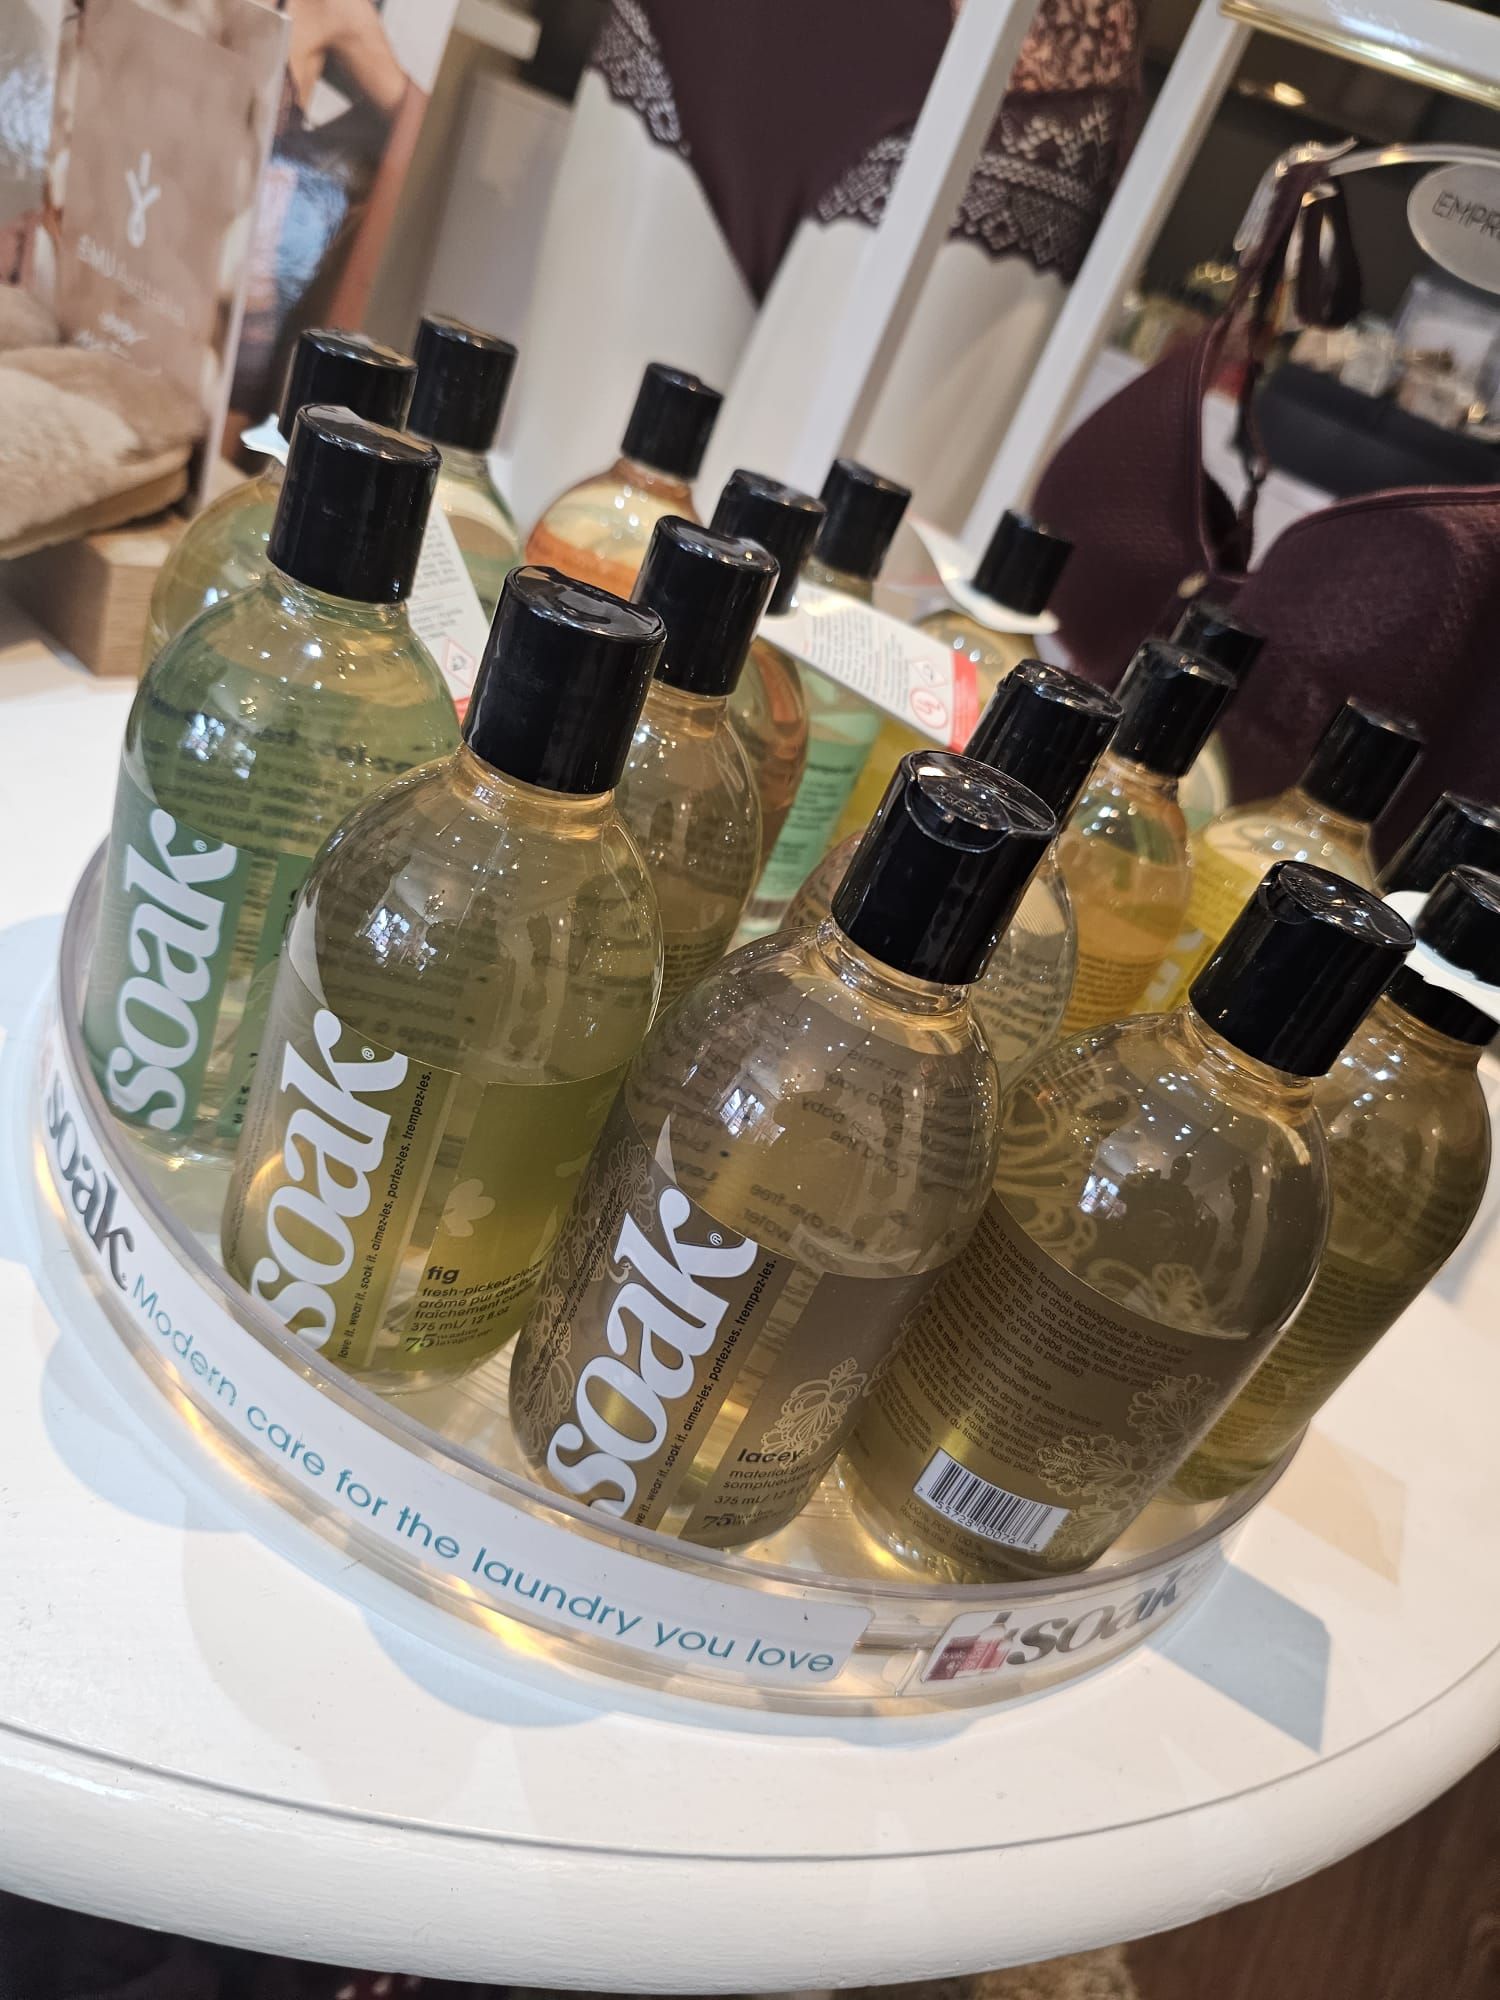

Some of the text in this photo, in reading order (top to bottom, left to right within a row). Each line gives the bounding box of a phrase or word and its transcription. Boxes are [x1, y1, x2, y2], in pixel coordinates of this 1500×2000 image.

[1431, 190, 1500, 239] EMPR
[105, 809, 237, 1130] soak
[251, 1008, 408, 1351] soak
[366, 1253, 378, 1264] it.
[360, 1265, 374, 1289] soak
[422, 1275, 511, 1297] fresh-picked
[427, 1265, 460, 1284] fig
[1038, 1271, 1073, 1300] formule
[415, 1299, 499, 1319] fraîchement
[418, 1297, 466, 1309] arôme
[470, 1294, 492, 1309] pur
[1048, 1296, 1074, 1319] choix
[349, 1302, 362, 1326] wear
[411, 1321, 435, 1332] 375
[471, 1316, 485, 1326] 12
[405, 1333, 436, 1352] 75
[546, 1187, 758, 1518] soak
[47, 1070, 835, 1673] soak Modern care for the laundry you love
[649, 1477, 663, 1501] wear
[665, 1443, 680, 1468] soak
[676, 1432, 688, 1446] it.
[737, 1448, 805, 1463] lacey
[714, 1495, 738, 1505] 375
[702, 1512, 736, 1529] 75
[936, 1500, 973, 1528] 55728
[1007, 1564, 1187, 1665] soak
